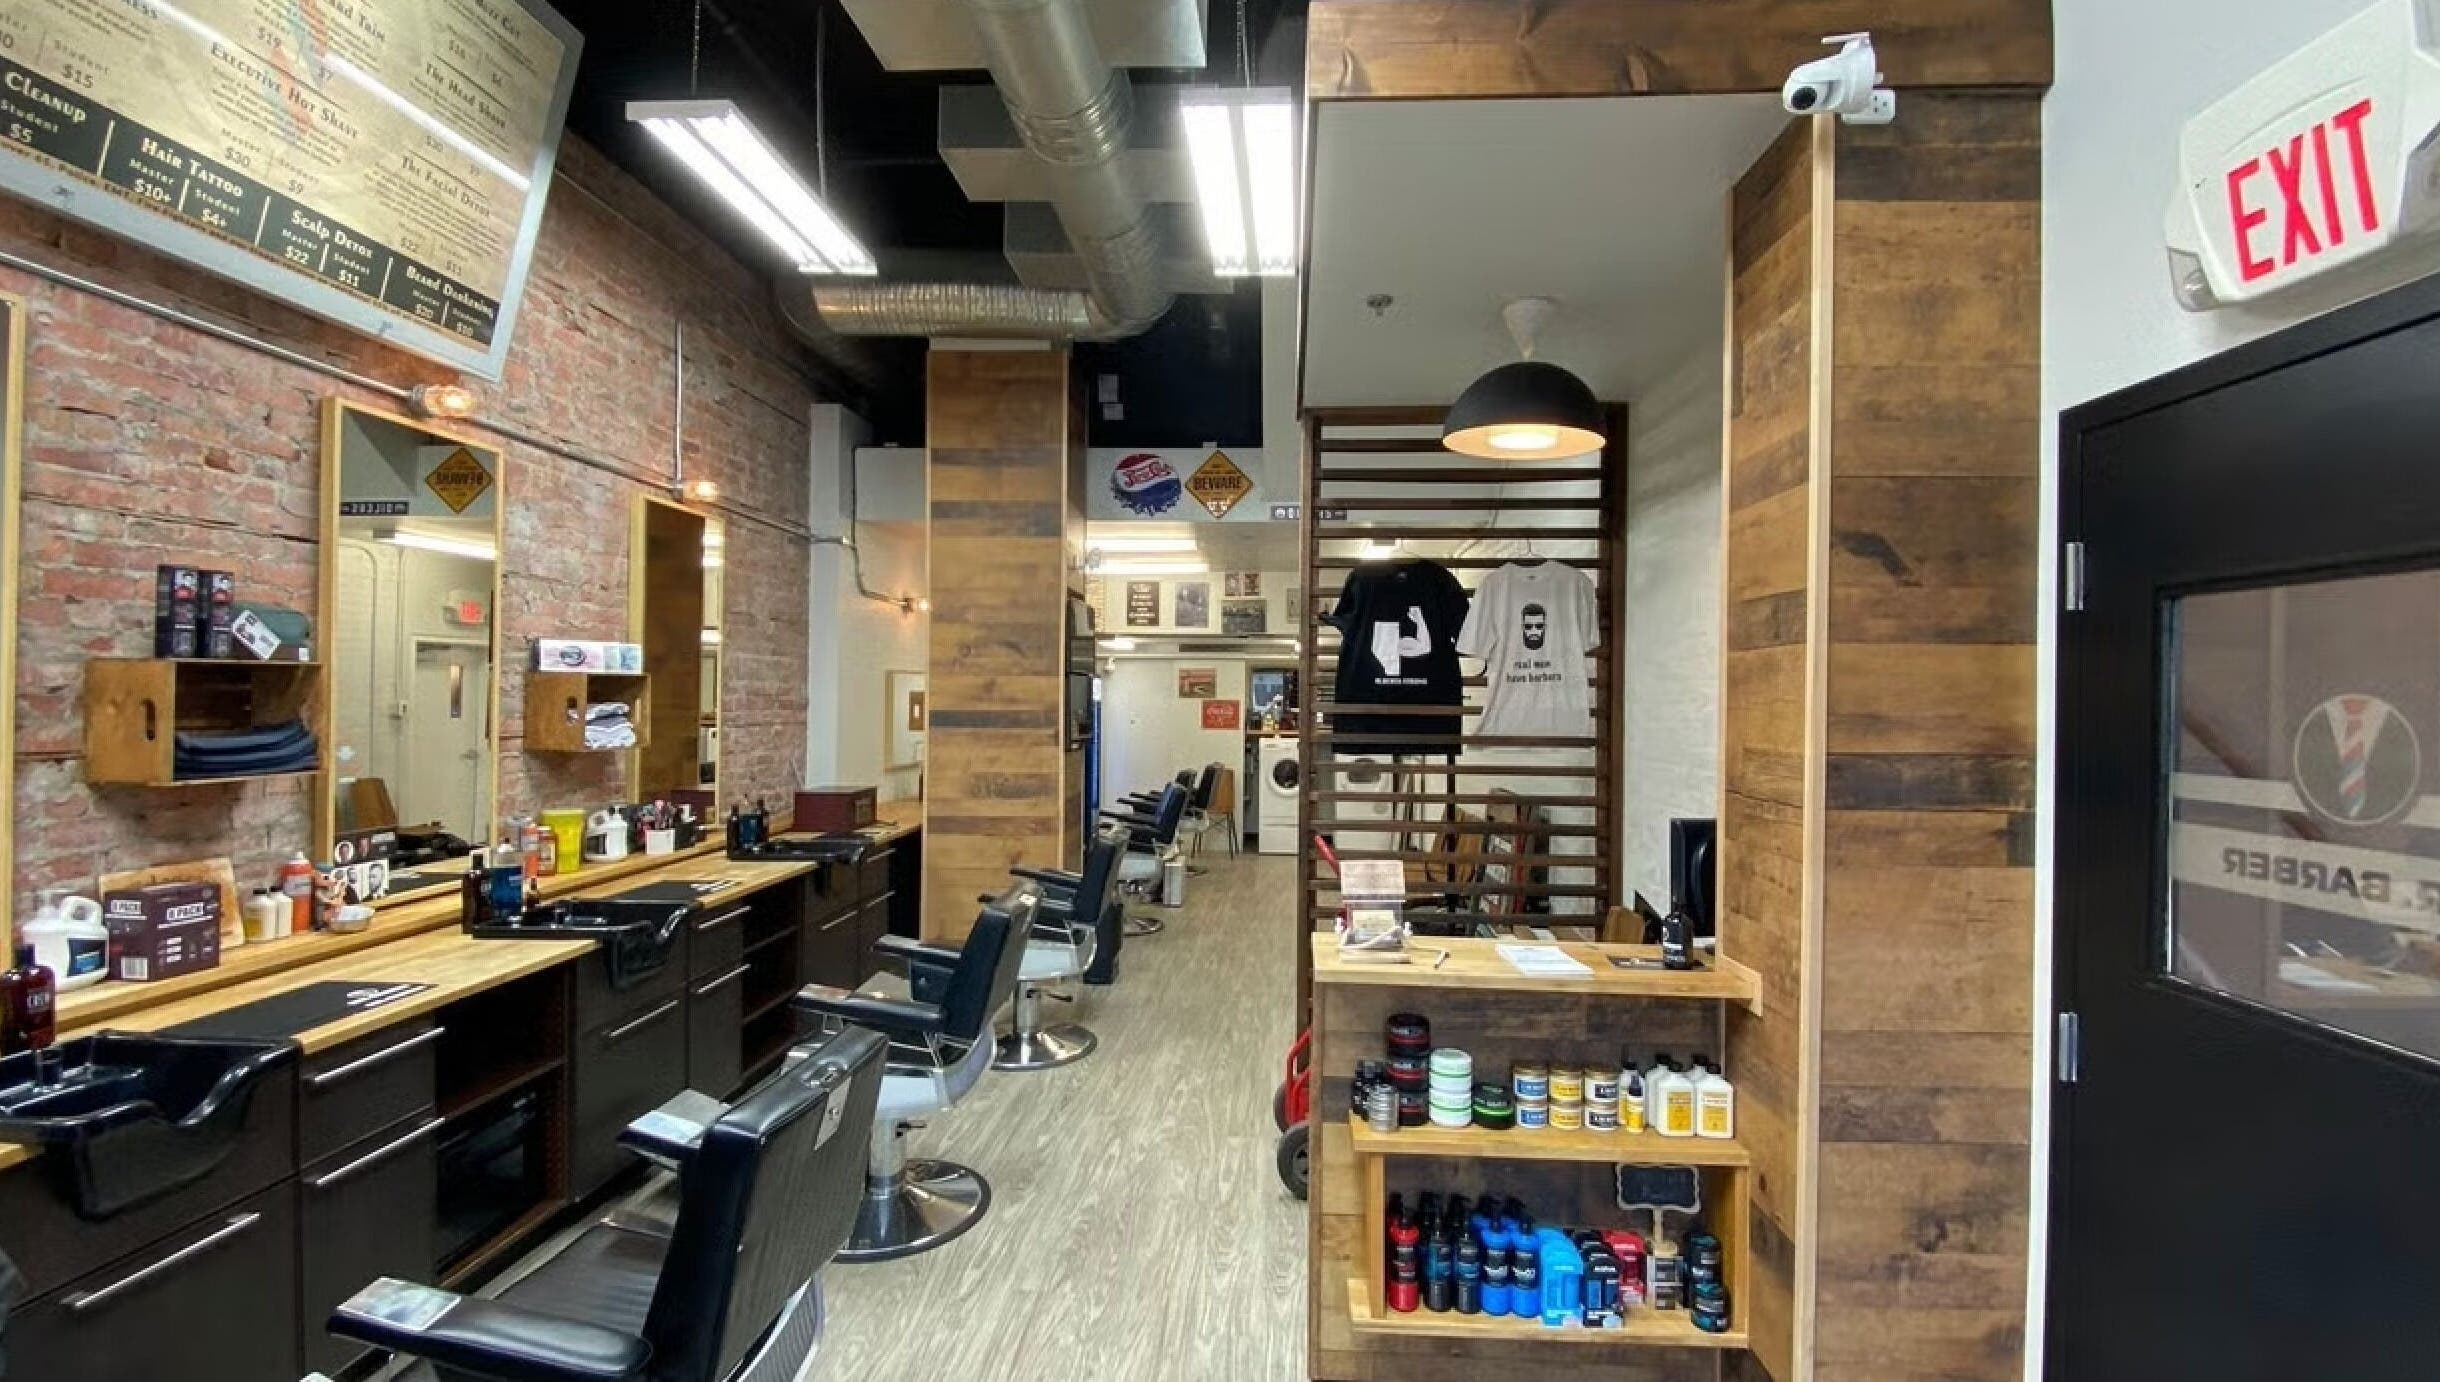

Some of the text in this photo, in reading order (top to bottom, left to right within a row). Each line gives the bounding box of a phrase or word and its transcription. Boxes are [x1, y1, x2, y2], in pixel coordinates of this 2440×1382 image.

[62, 64, 95, 88] $15
[5, 71, 87, 123] Cleanup
[9, 123, 33, 143] $5
[141, 137, 182, 169] Hair
[189, 159, 244, 198] Tattoo
[2226, 97, 2380, 282] EXIT
[290, 208, 330, 240] Scalp
[334, 229, 374, 259] Detox
[1193, 476, 1242, 491] BEWARE
[1513, 657, 1532, 670] real
[1506, 671, 1526, 683] have
